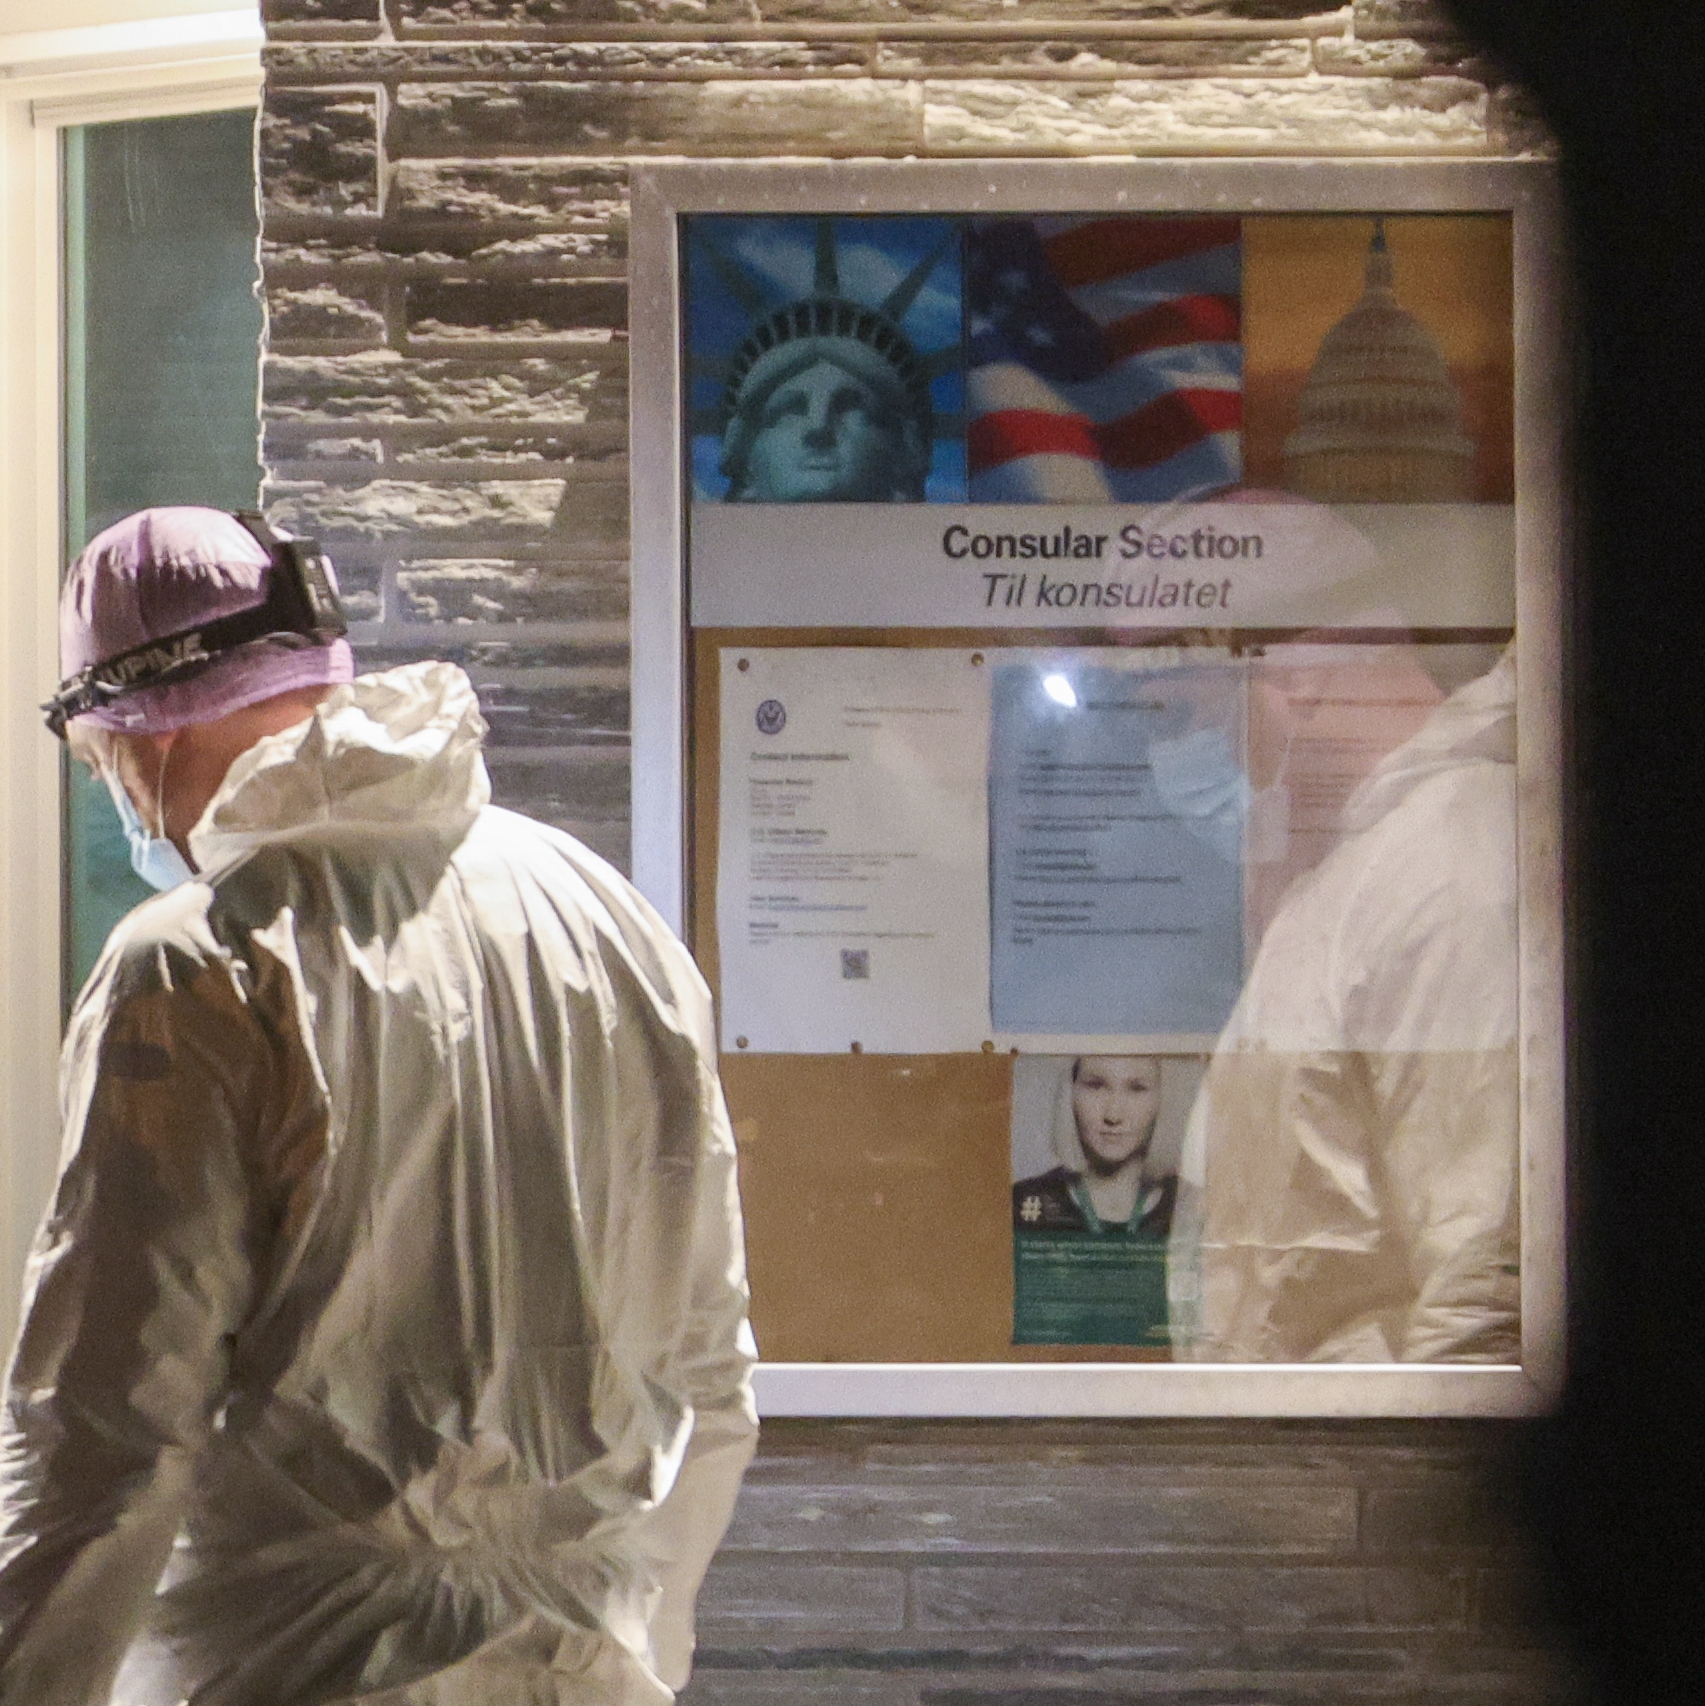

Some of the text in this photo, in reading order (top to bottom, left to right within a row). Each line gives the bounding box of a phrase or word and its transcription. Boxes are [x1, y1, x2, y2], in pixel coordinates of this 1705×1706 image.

[942, 524, 1264, 559] Consular Section
[982, 573, 1233, 609] Til konsulatet
